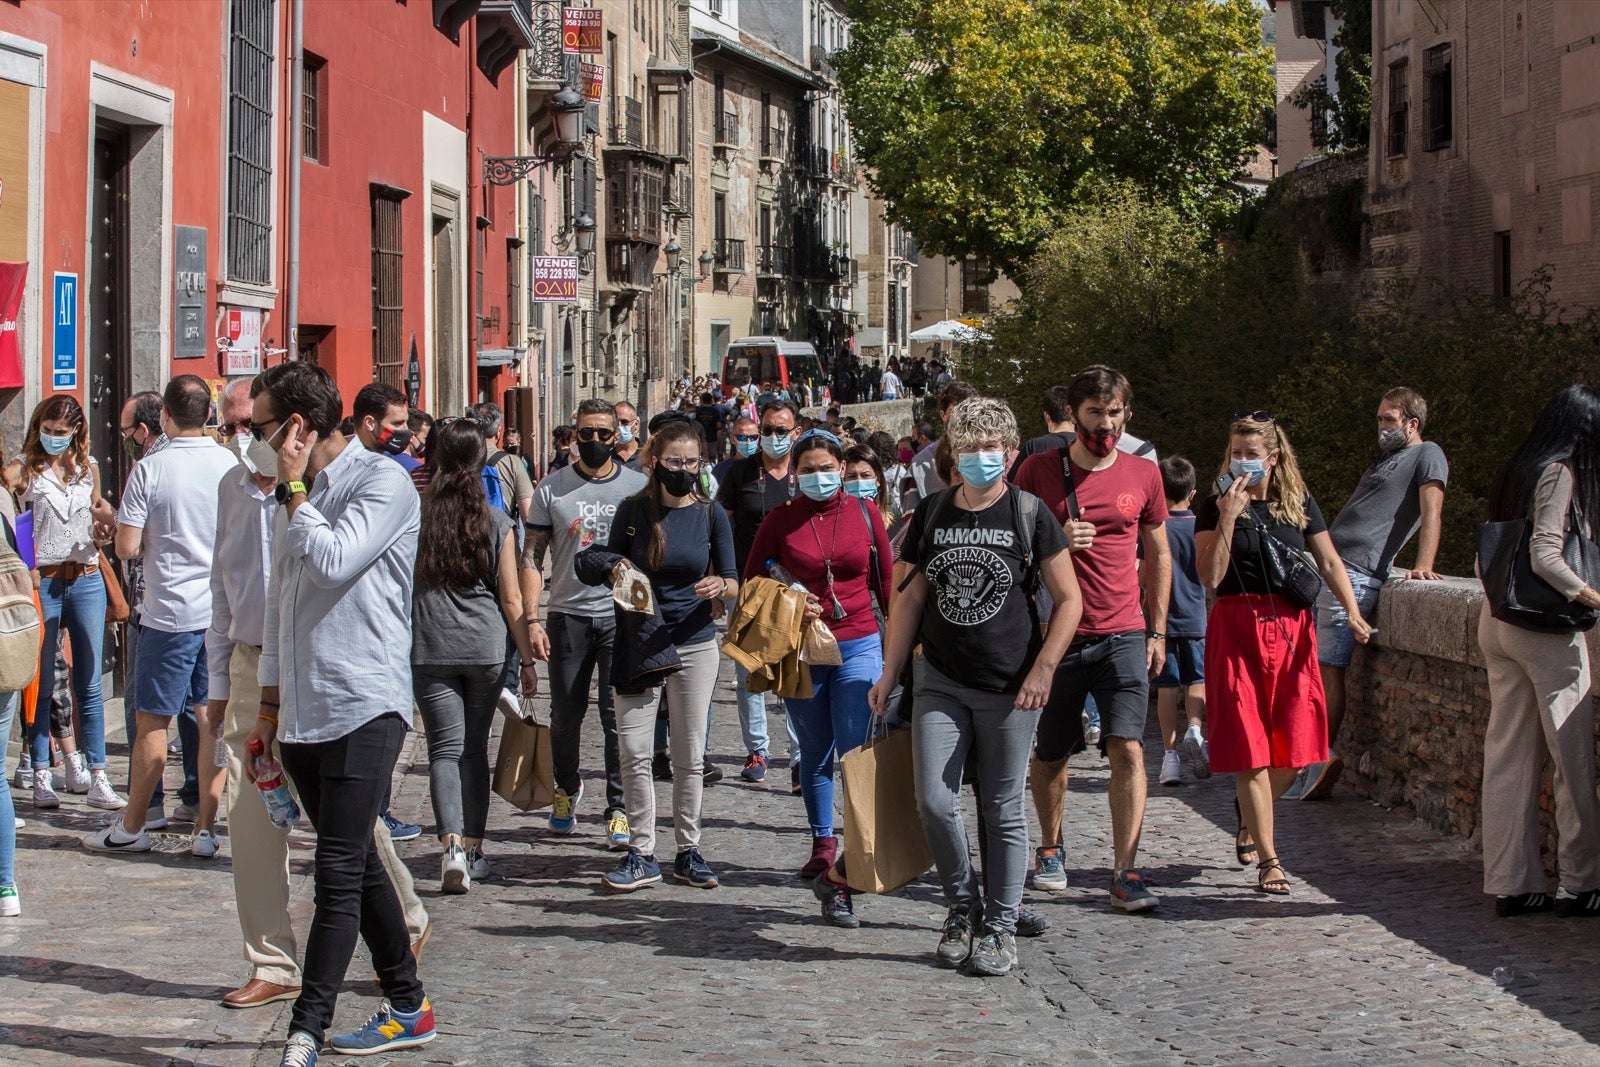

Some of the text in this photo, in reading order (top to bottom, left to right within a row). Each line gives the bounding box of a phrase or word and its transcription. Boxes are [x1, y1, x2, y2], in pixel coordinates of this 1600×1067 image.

[565, 10, 601, 19] VENDE
[536, 259, 576, 267] VENDE
[536, 268, 576, 279] 958 228 930
[535, 281, 575, 295] OASIS
[576, 501, 617, 516] Take
[583, 516, 597, 529] a
[933, 528, 1014, 547] RAMONES
[942, 548, 999, 565] JOHNNY
[995, 567, 1010, 601] JOEY
